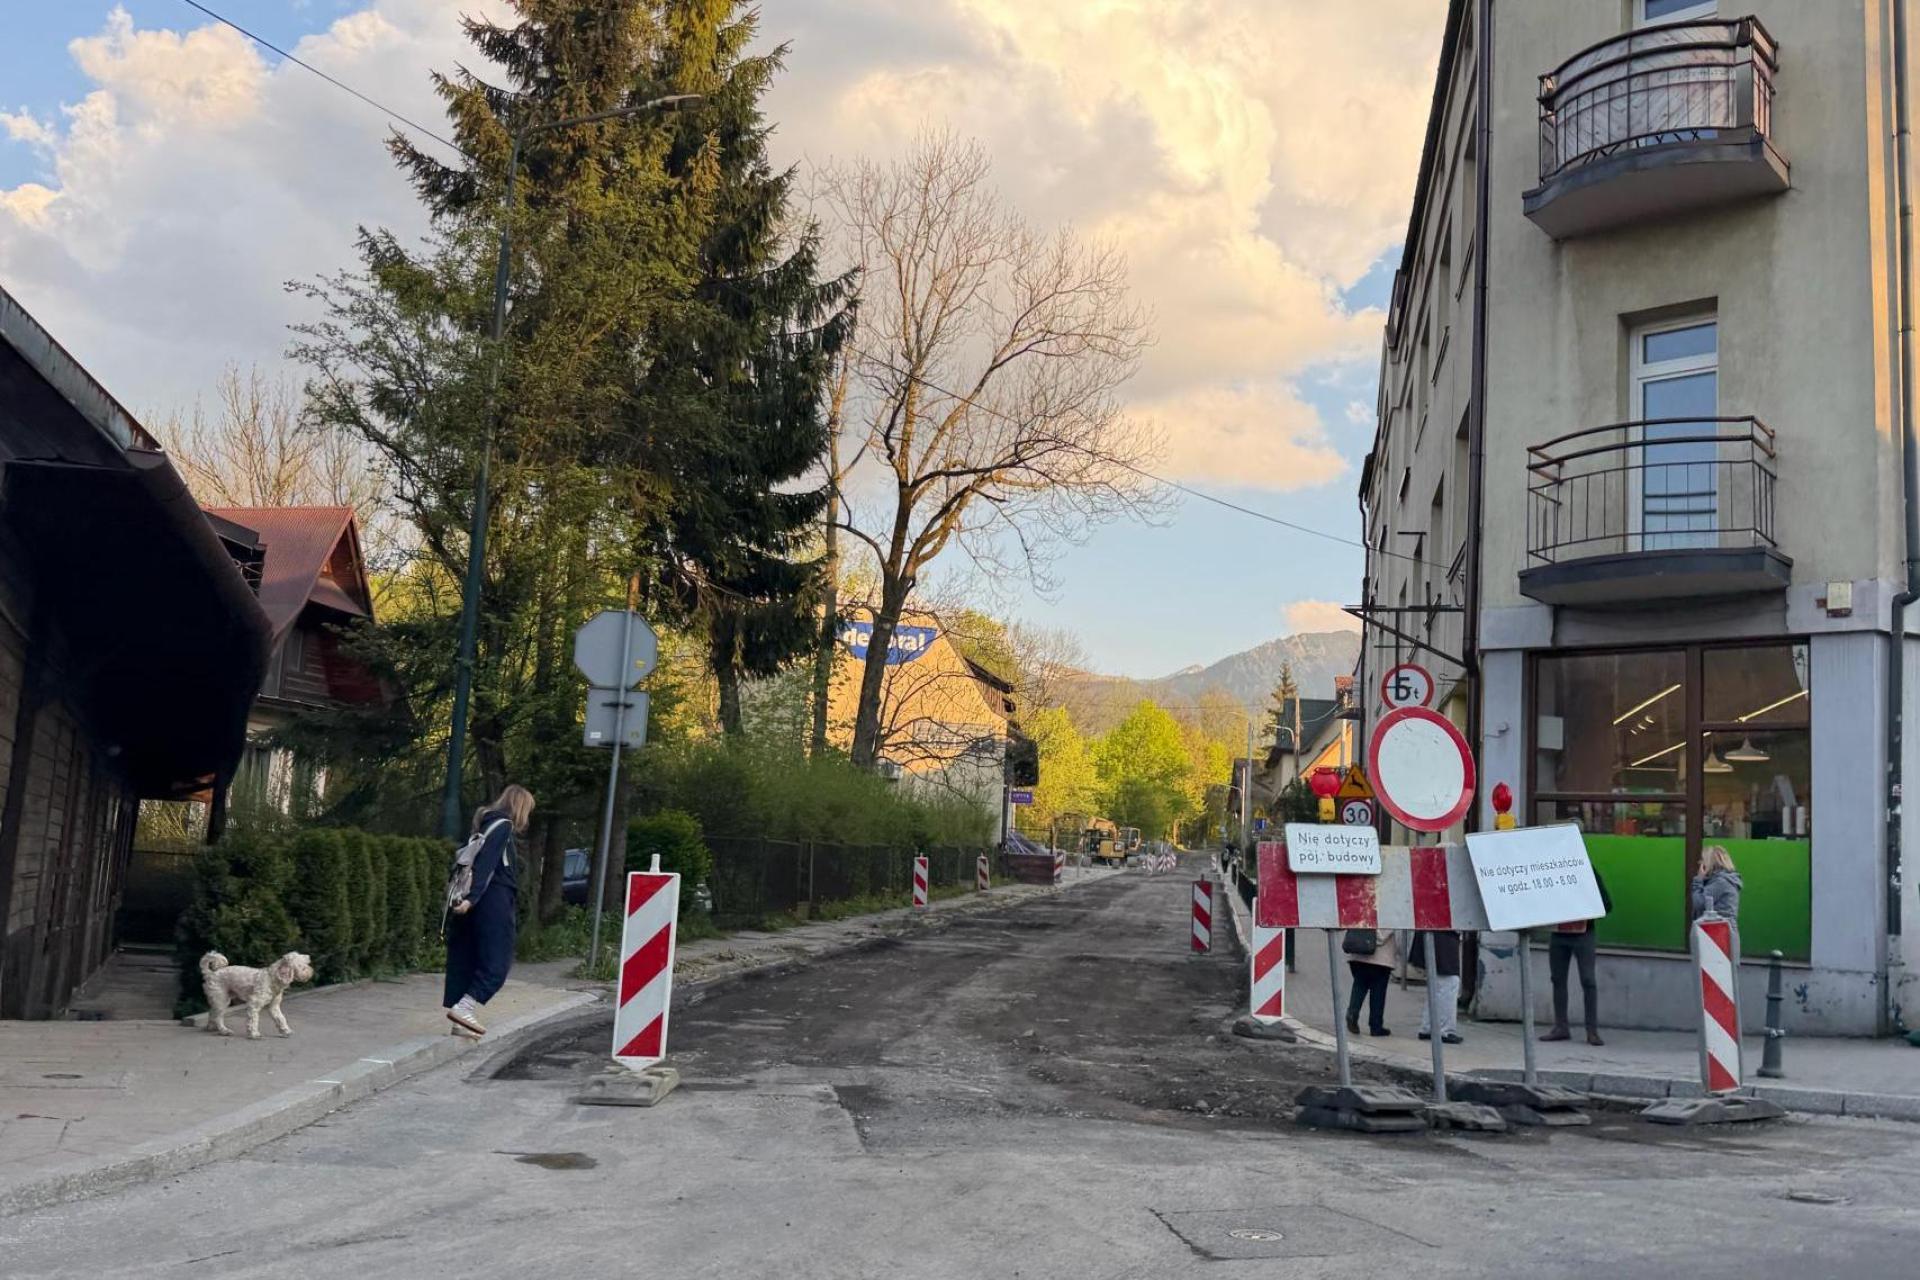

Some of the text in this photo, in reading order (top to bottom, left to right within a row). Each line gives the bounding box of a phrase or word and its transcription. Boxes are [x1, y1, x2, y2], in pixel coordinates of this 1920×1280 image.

[1345, 808, 1368, 823] 30
[1324, 833, 1370, 847] dotyczy
[1327, 851, 1374, 865] budowy
[1480, 866, 1495, 878] Nie
[1496, 864, 1528, 877] dotyczy
